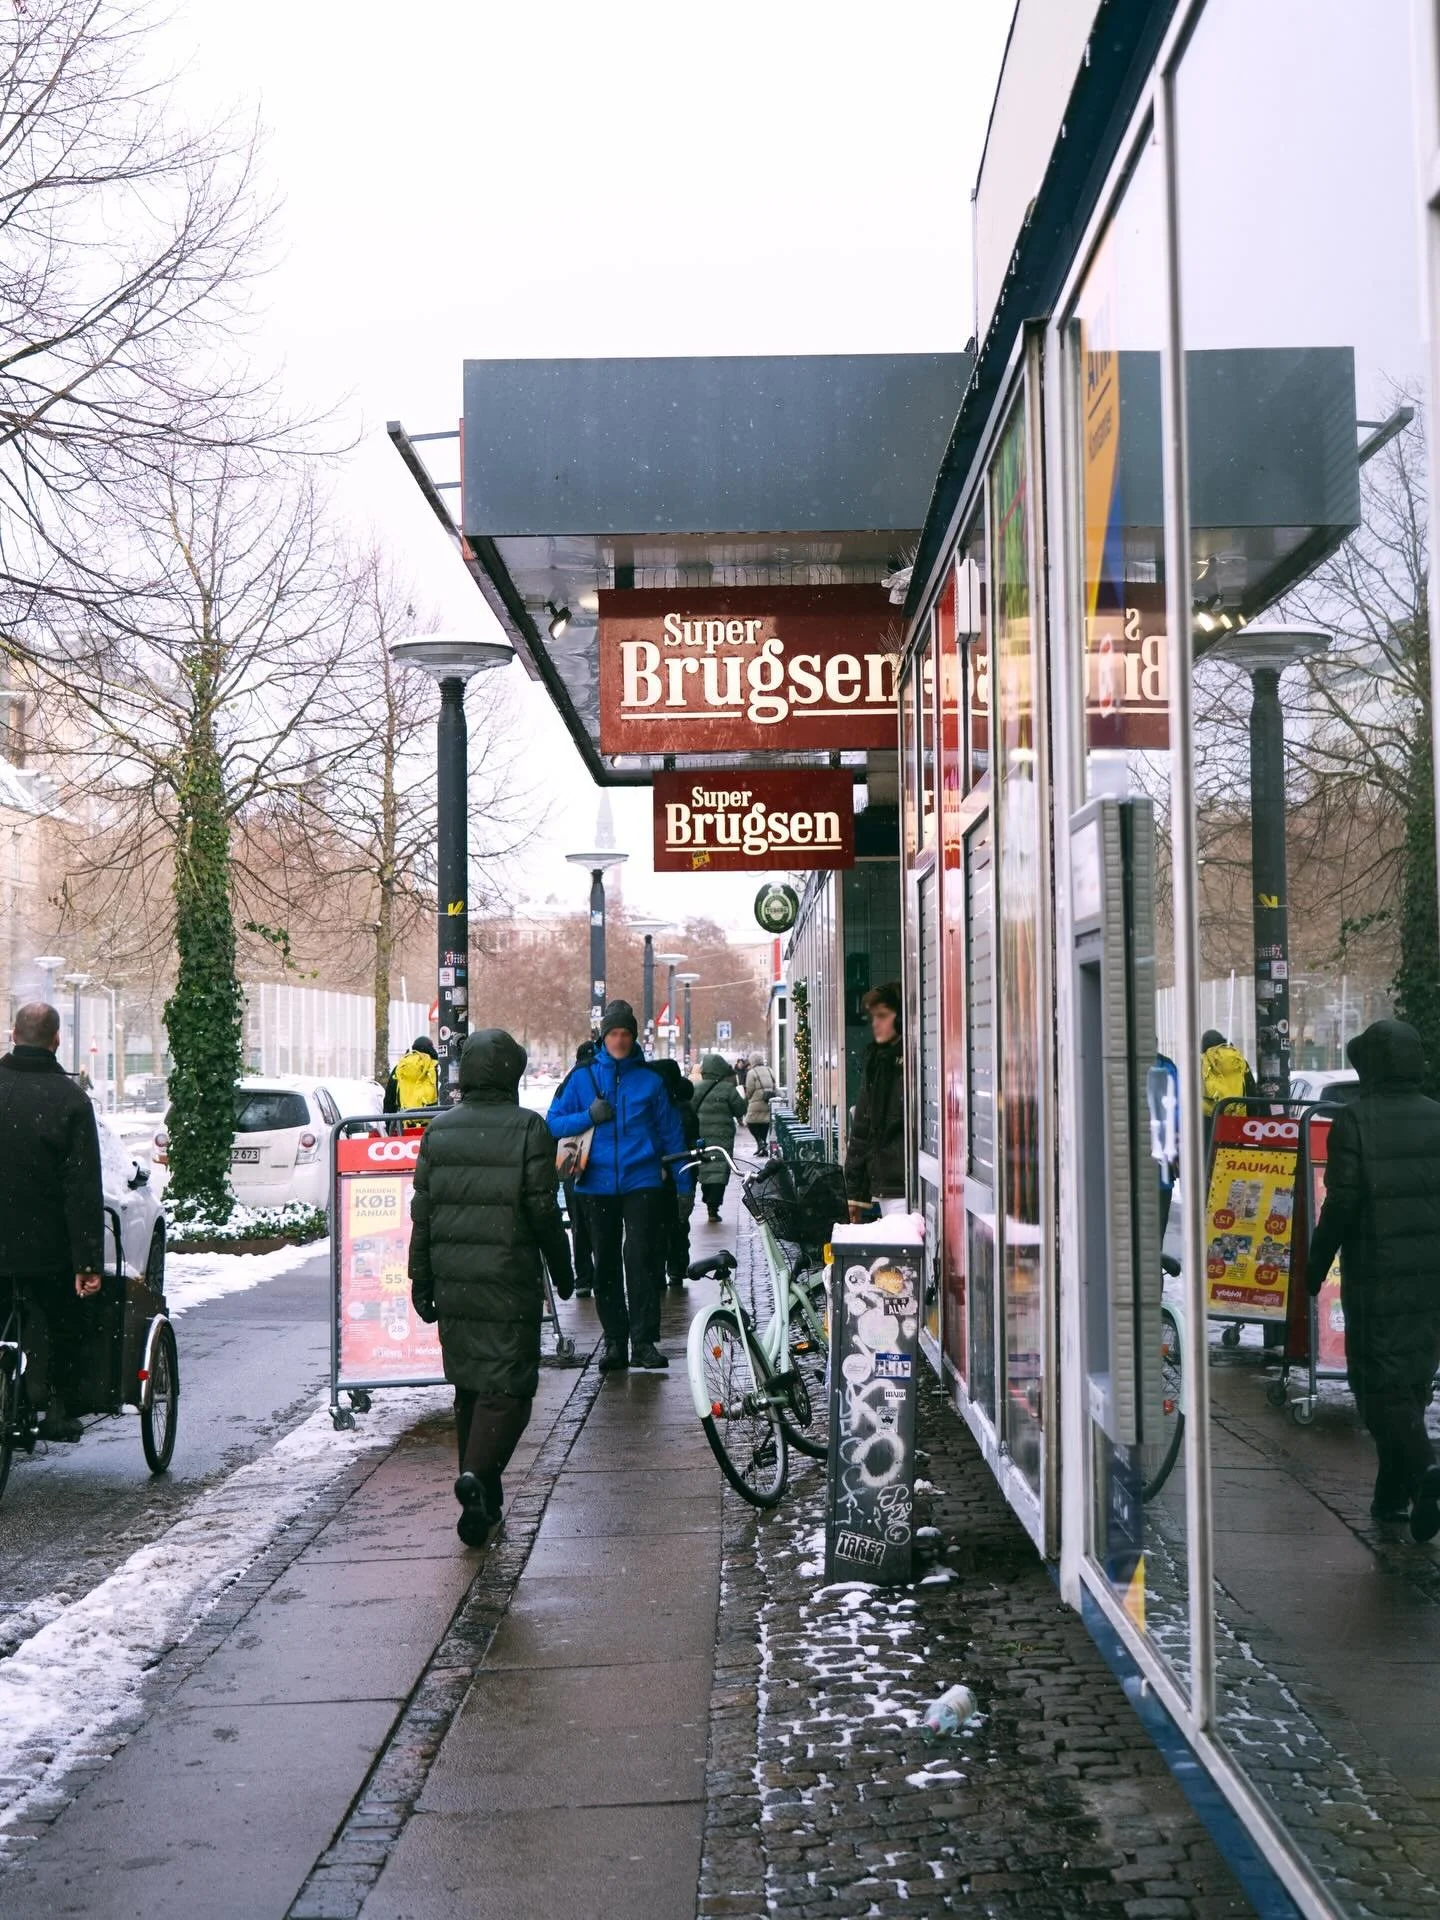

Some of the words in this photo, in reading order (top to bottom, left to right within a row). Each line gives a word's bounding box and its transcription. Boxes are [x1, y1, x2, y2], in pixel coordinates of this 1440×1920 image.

[664, 613, 762, 655] Super
[620, 638, 900, 724] Brugsen
[692, 786, 752, 813] Super
[666, 803, 842, 856] Brugsen
[241, 1150, 258, 1160] 673
[368, 1140, 420, 1161] coo
[355, 1195, 396, 1208] KØB
[356, 1209, 396, 1217] JANUAR
